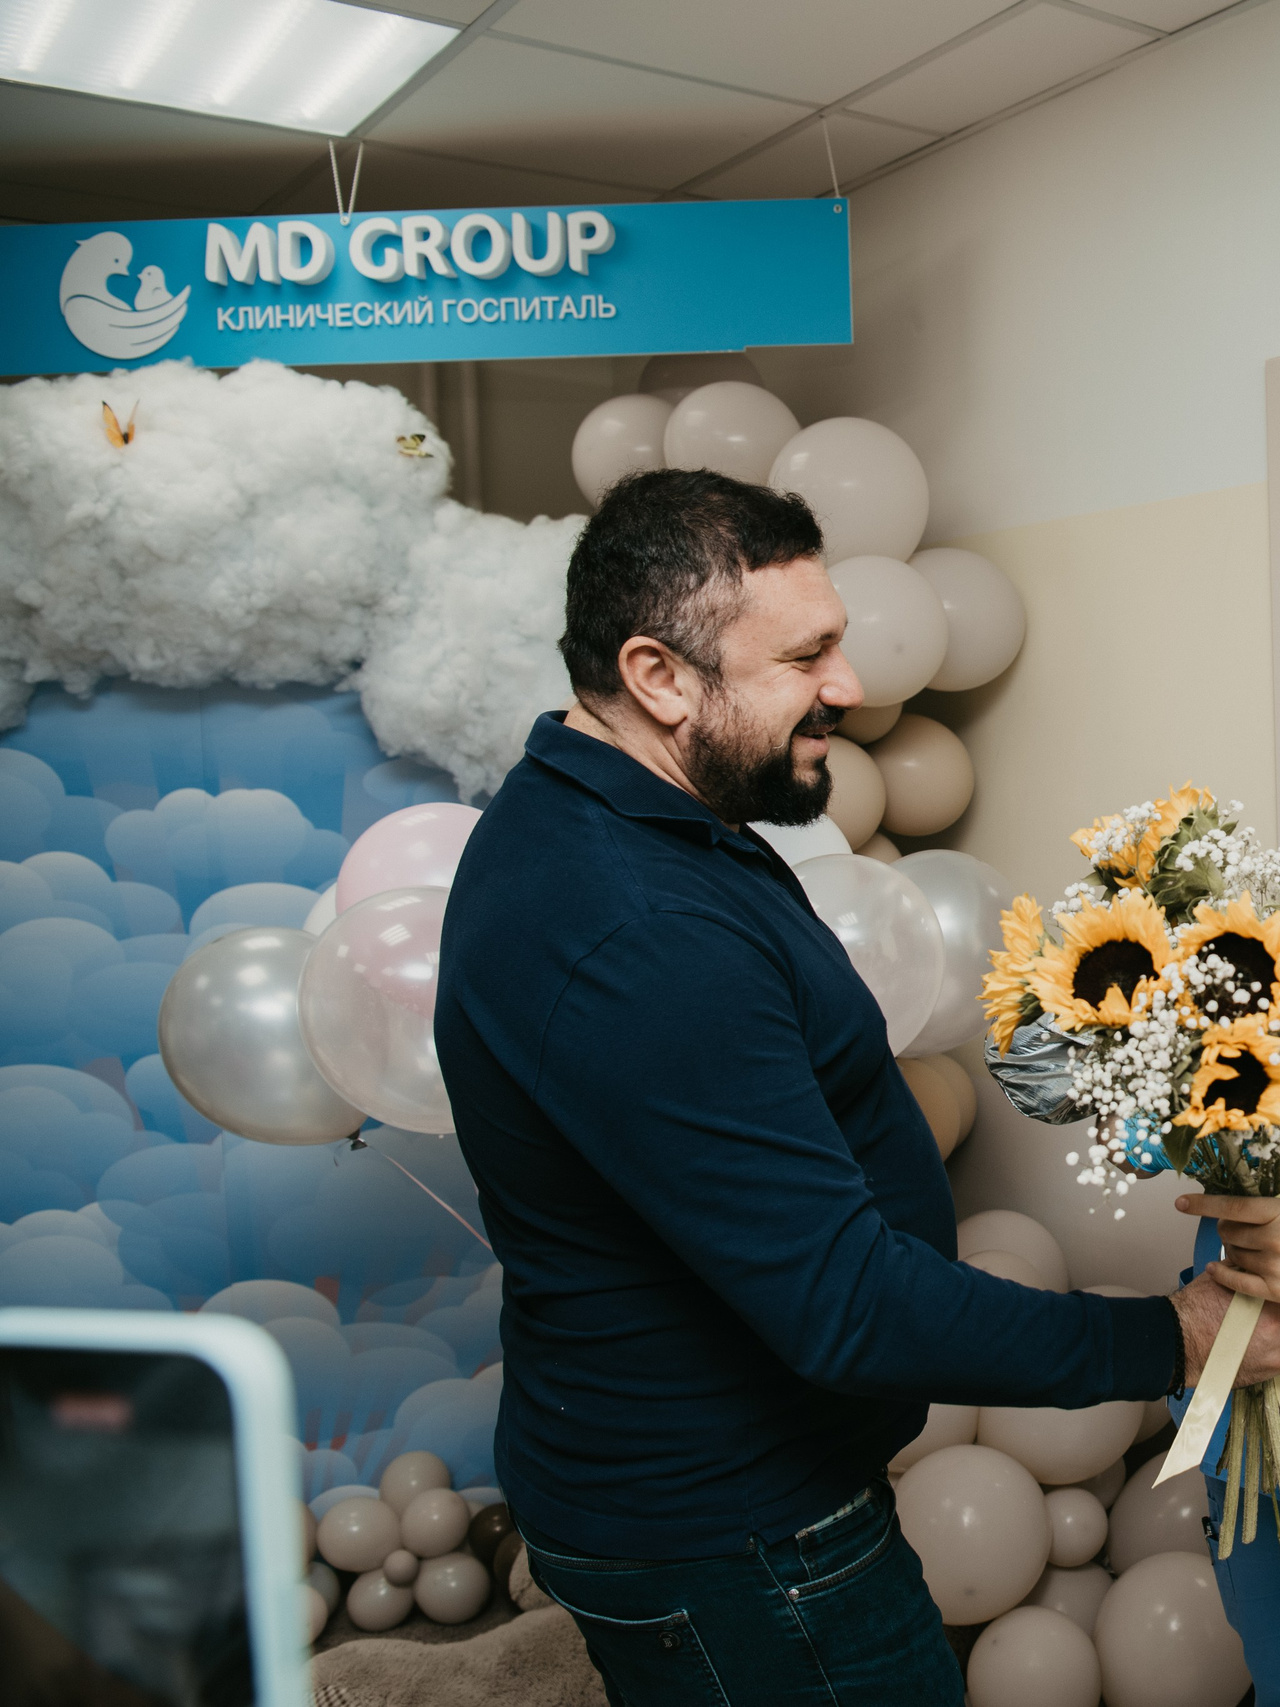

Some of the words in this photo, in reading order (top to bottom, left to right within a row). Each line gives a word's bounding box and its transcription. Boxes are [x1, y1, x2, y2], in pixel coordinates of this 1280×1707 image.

[205, 221, 335, 287] MD
[349, 210, 616, 284] GROUP
[217, 295, 434, 331] КЛИНИЧЕСКИЙ
[442, 294, 616, 325] ГОСПИТАЛЬ
